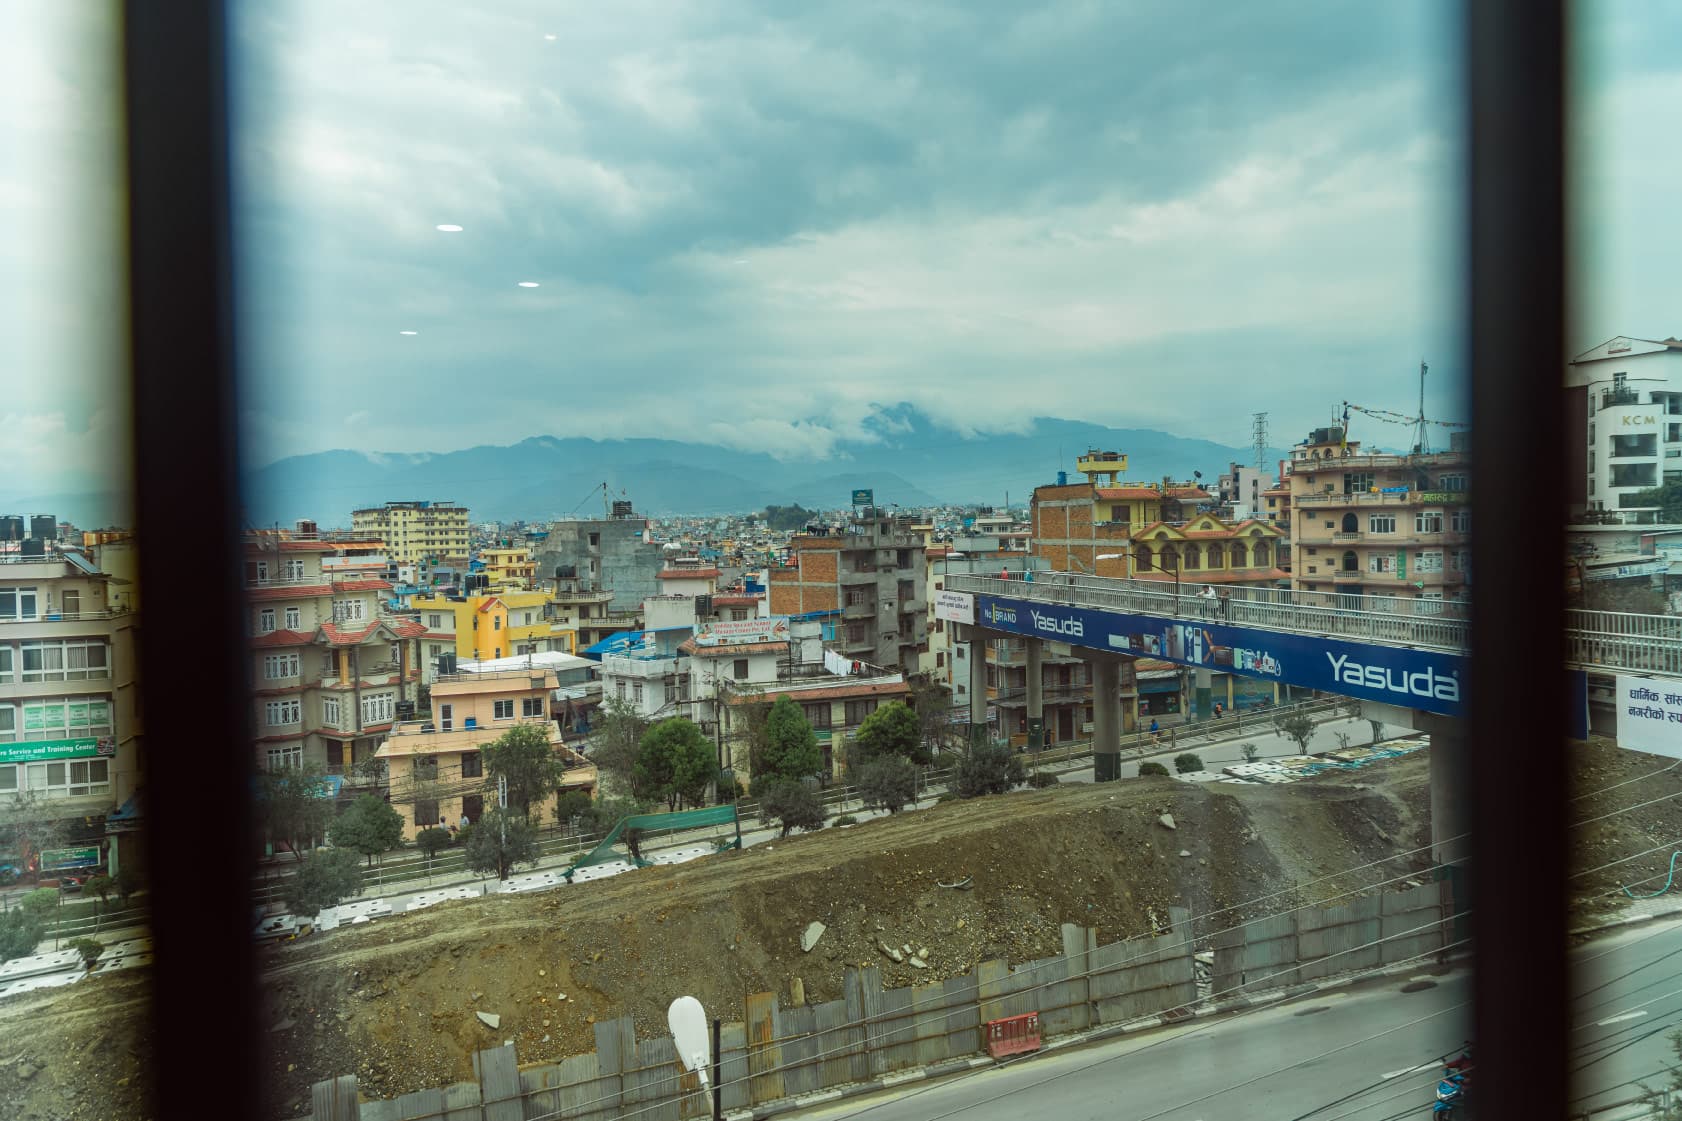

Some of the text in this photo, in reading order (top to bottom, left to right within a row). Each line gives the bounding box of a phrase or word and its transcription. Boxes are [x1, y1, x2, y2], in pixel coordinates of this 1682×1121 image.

[1622, 415, 1656, 426] KCM
[996, 611, 1017, 624] BRAND
[1030, 609, 1083, 637] Yasuda
[1326, 651, 1460, 702] Yasuda
[1630, 688, 1659, 701] धार्मिक
[9, 747, 31, 756] Service
[33, 746, 46, 754] and
[47, 745, 74, 754] Training
[75, 743, 96, 751] Center
